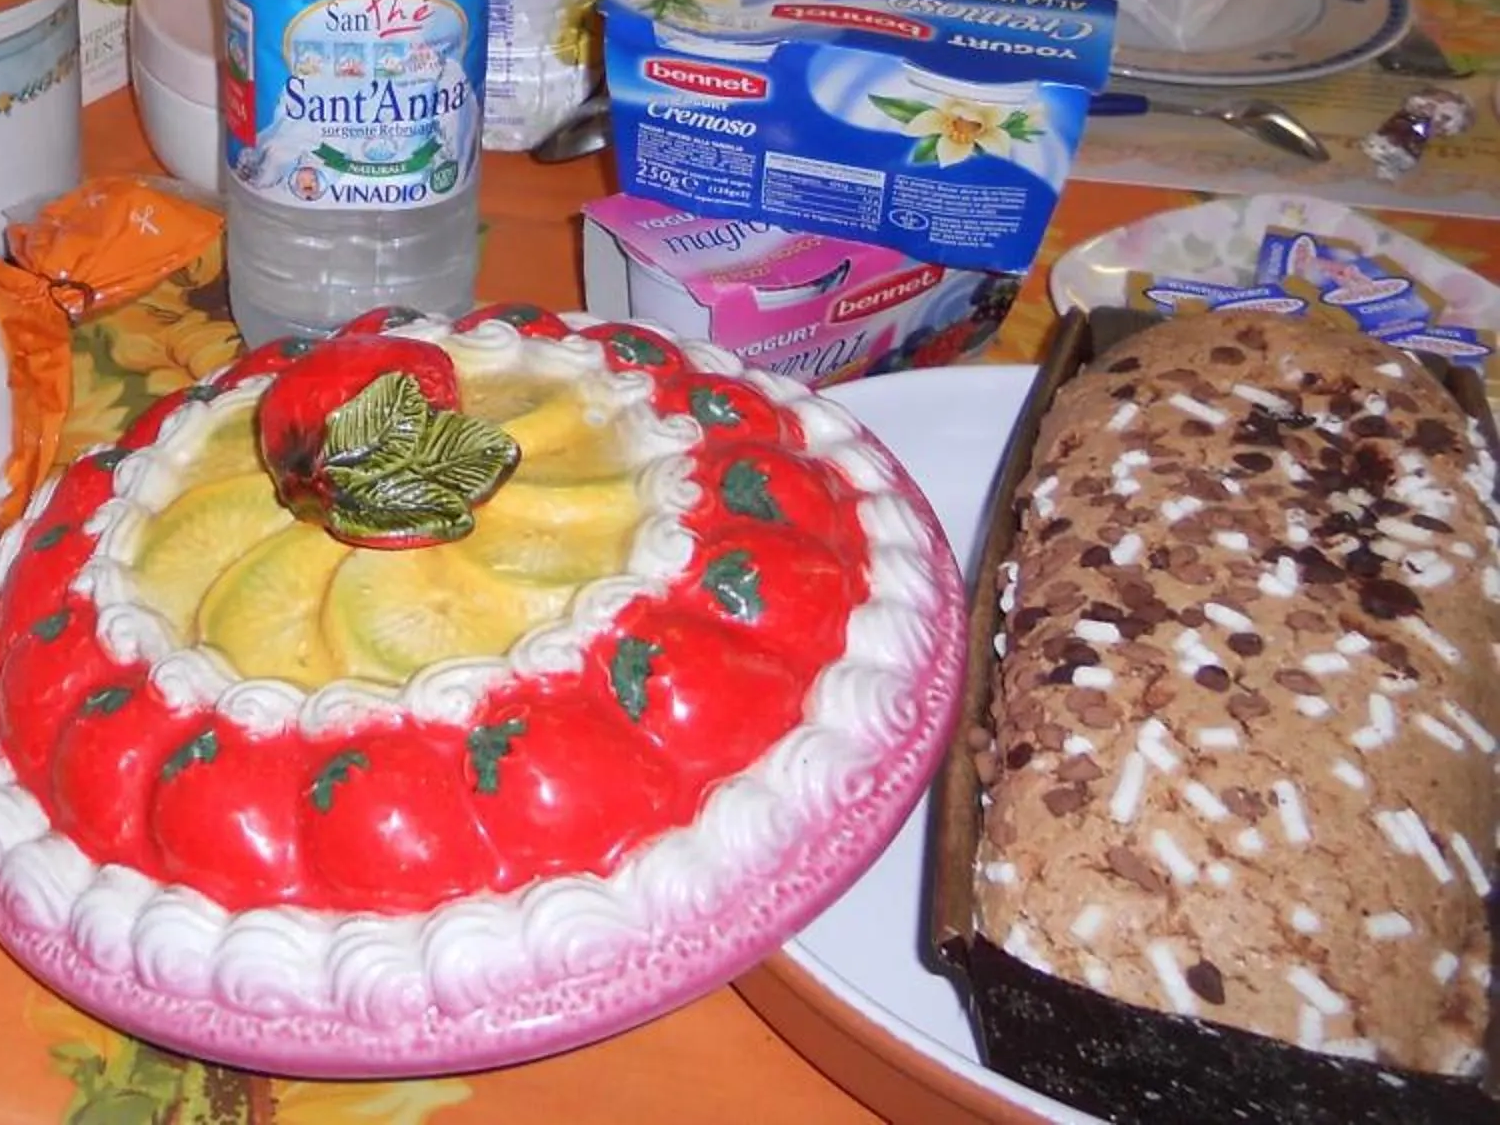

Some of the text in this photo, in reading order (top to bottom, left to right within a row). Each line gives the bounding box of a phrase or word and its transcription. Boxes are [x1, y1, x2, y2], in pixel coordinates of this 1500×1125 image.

[781, 5, 921, 40] bennet
[946, 33, 1078, 60] YOGURT
[652, 62, 760, 95] bennet
[285, 74, 468, 126] Sant'Anna
[647, 101, 757, 139] Cremoso
[329, 182, 428, 204] VINADIO
[837, 270, 938, 317] bennet
[734, 322, 822, 358] YOGURT
